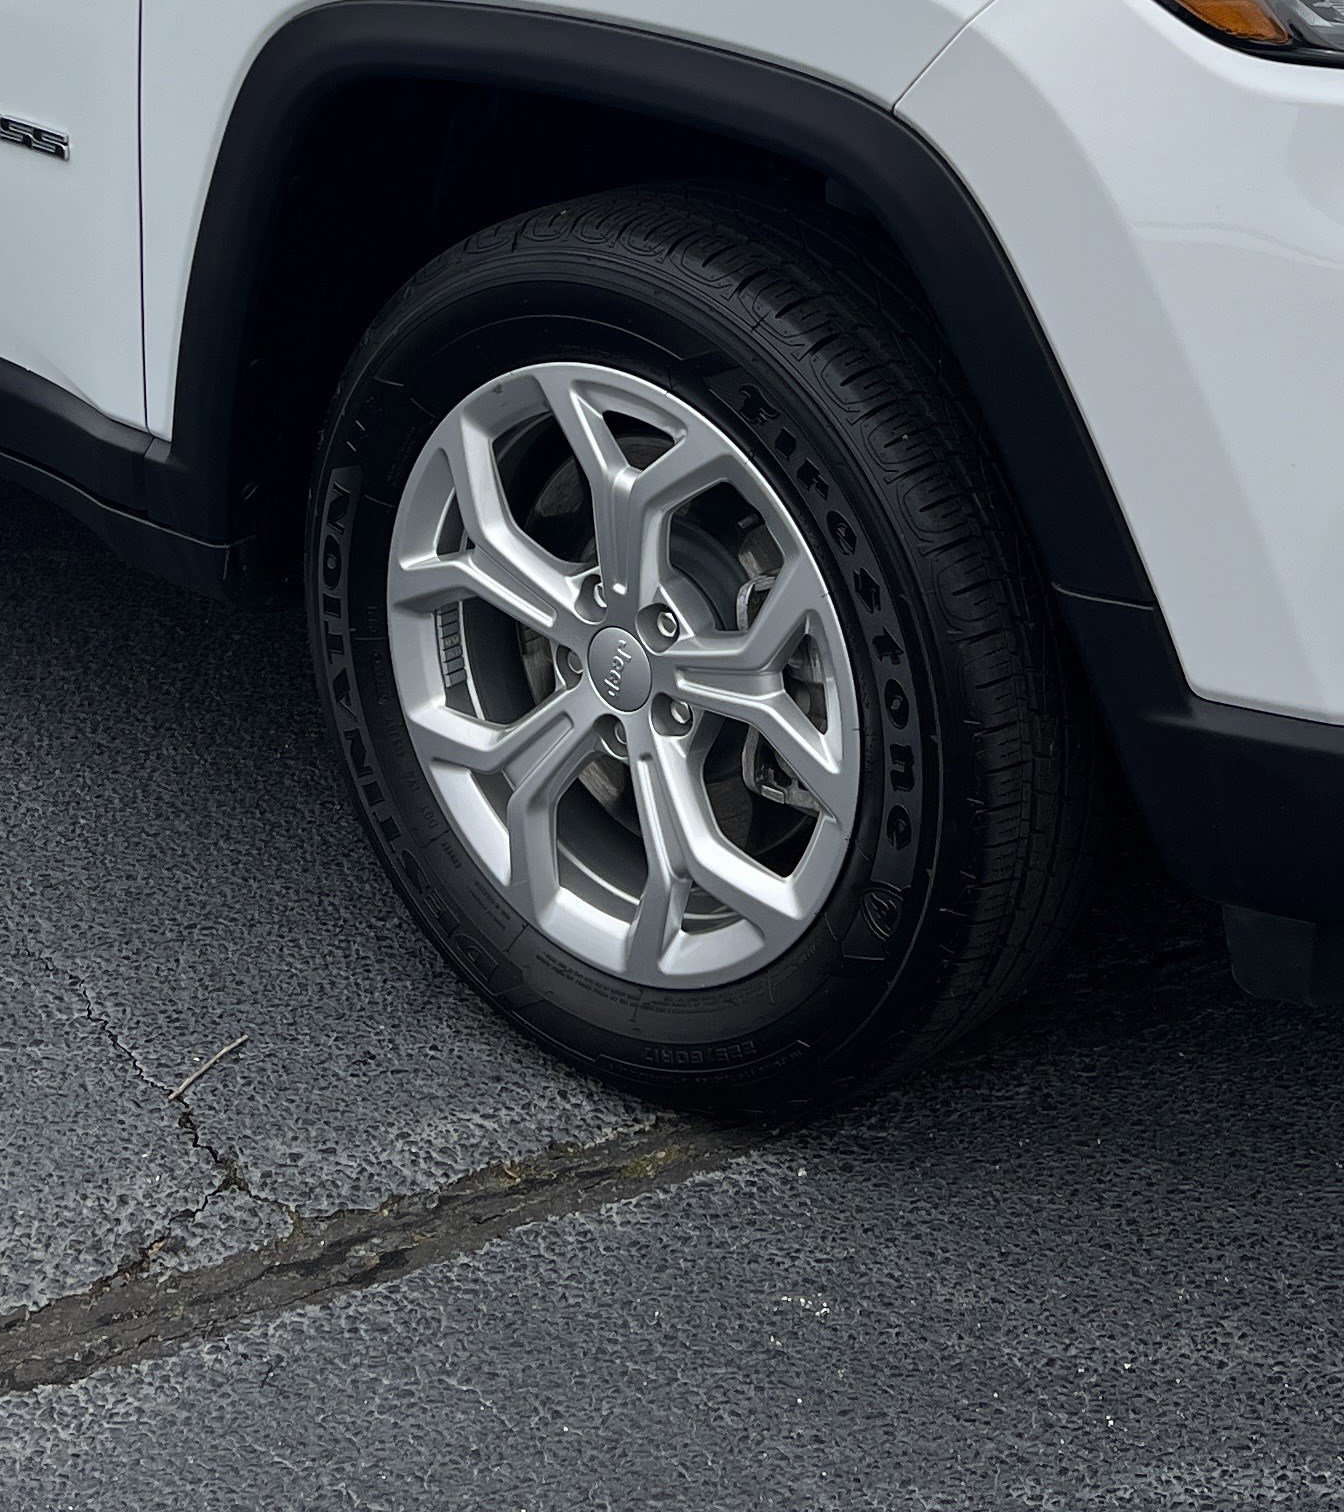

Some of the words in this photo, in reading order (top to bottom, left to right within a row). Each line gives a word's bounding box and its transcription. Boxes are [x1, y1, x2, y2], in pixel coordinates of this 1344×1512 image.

[322, 481, 500, 984] DESTINATION
[604, 639, 632, 697] Jeep
[736, 384, 916, 852] Firestone
